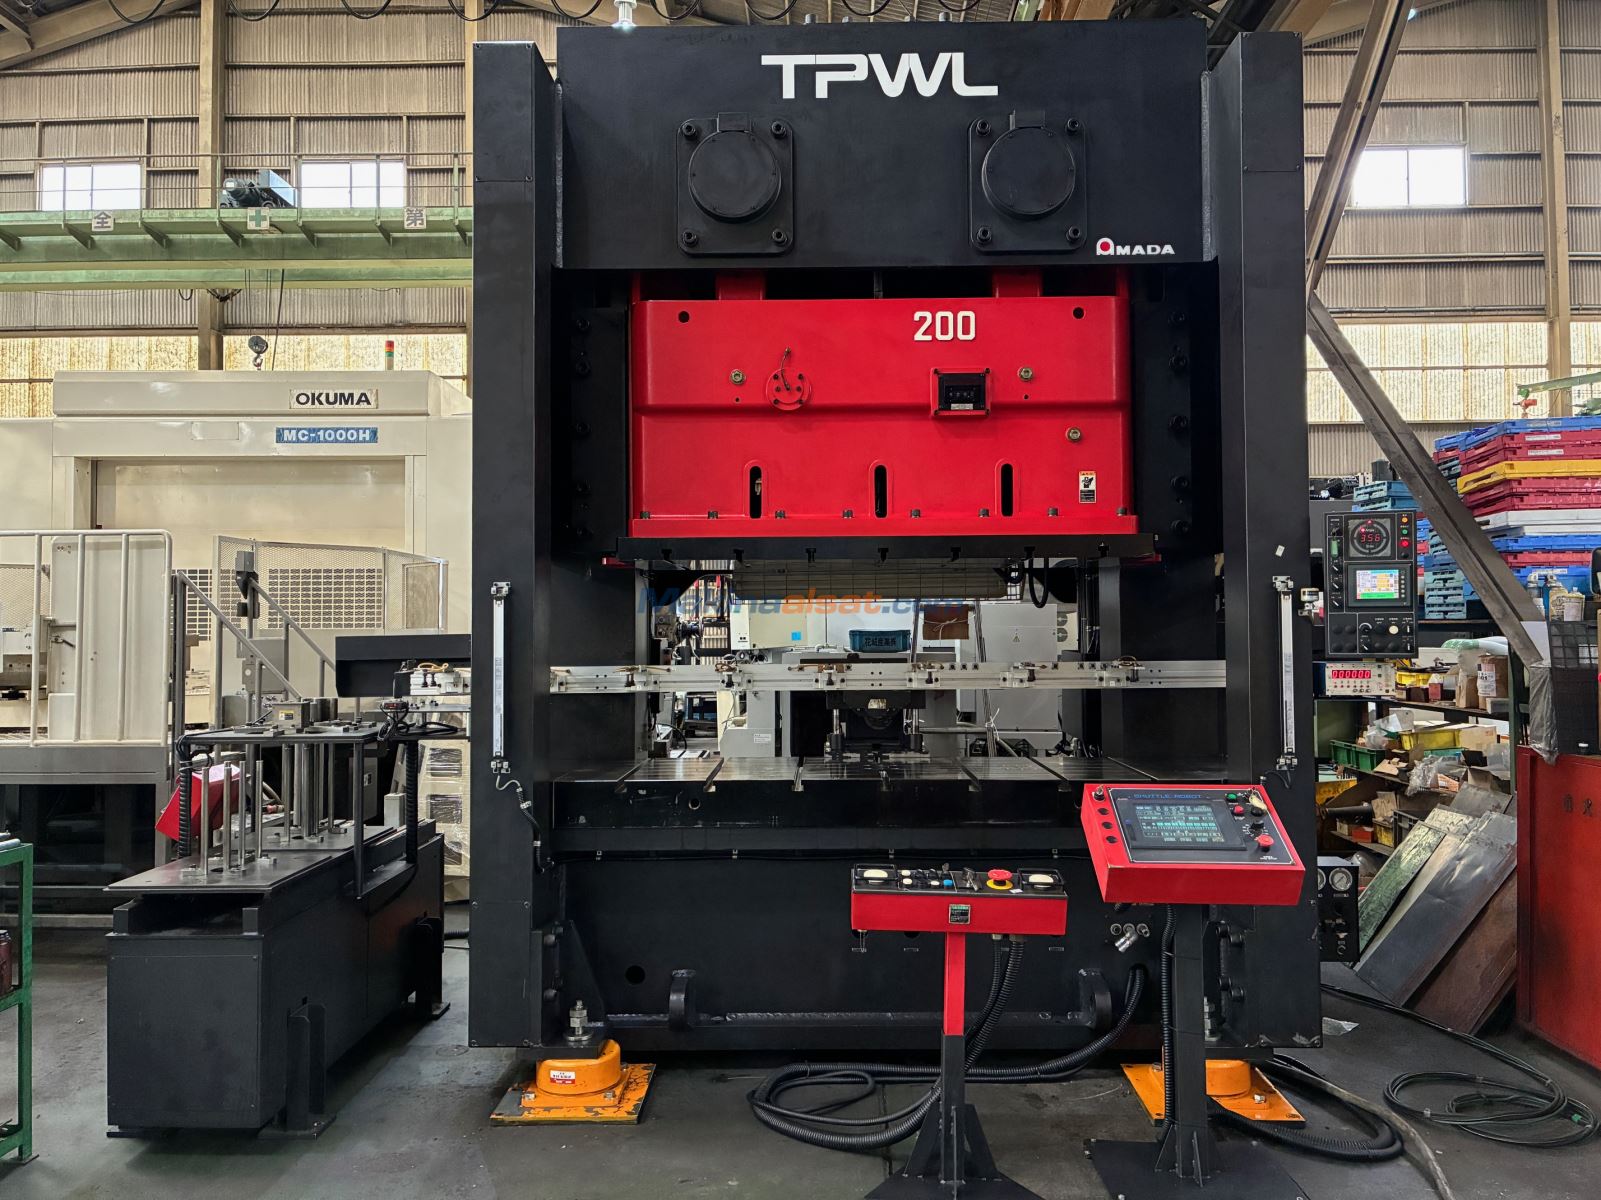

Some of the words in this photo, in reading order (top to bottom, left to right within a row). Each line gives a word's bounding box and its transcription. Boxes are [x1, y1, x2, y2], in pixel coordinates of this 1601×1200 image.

[761, 52, 999, 99] TPWL
[93, 211, 113, 230] 全
[405, 207, 426, 229] 第
[1096, 237, 1176, 256] AMADA
[913, 311, 976, 341] 200
[295, 392, 372, 406] OKUMA
[283, 429, 370, 441] MC-1000H
